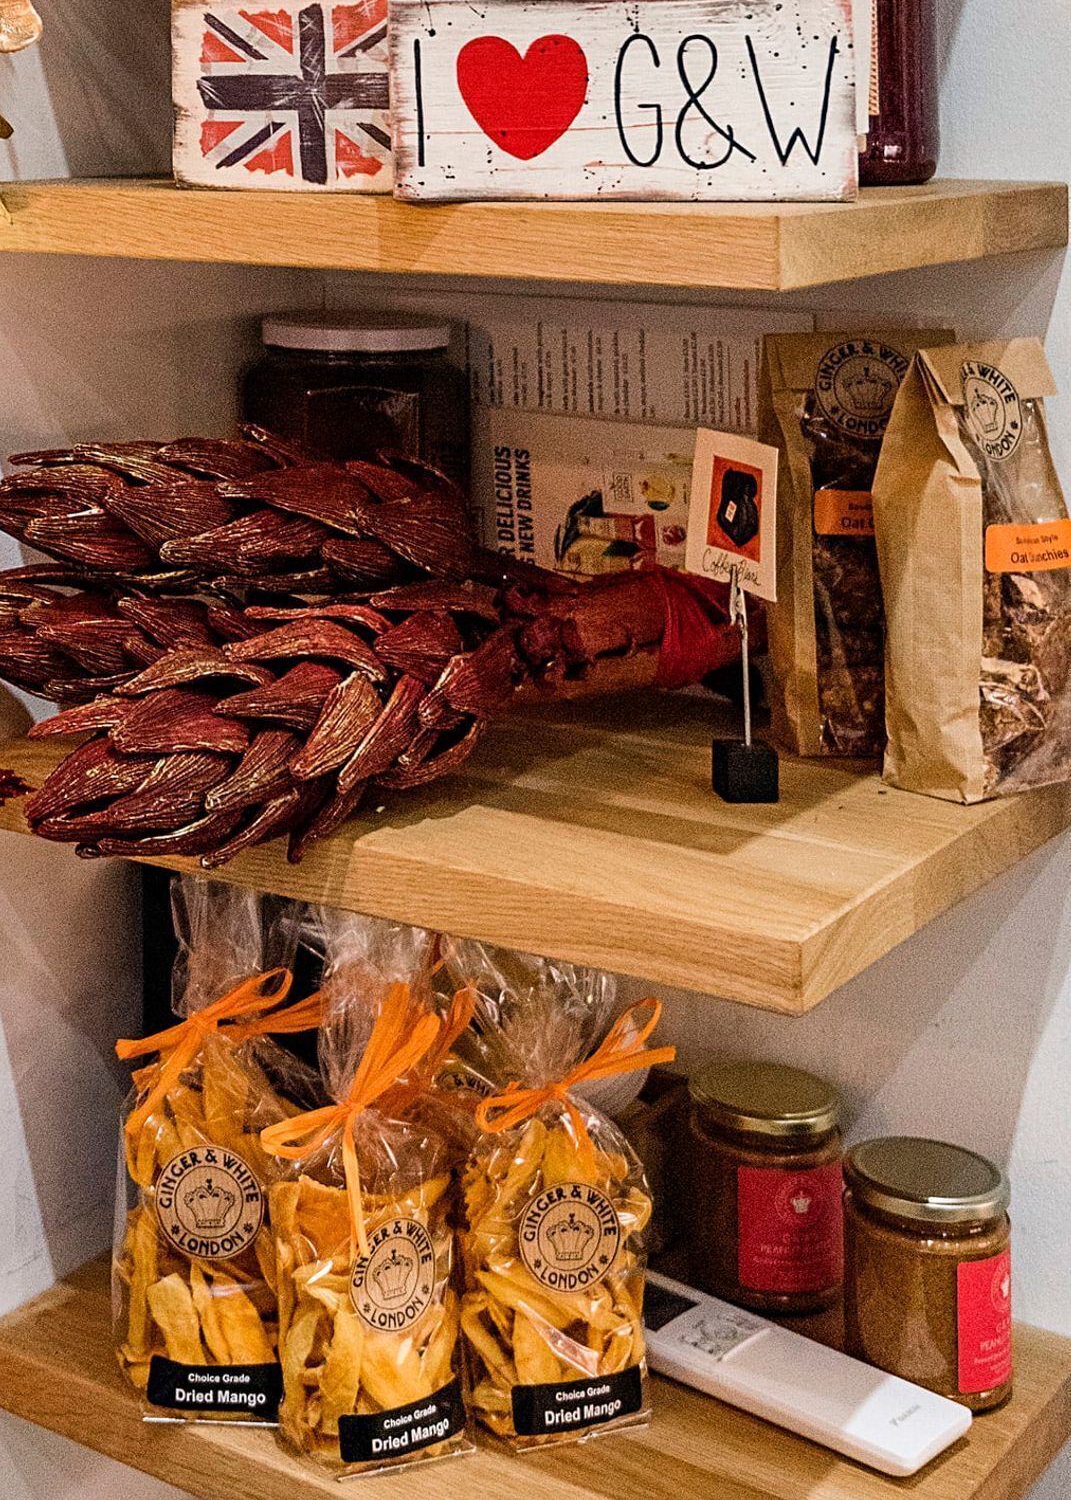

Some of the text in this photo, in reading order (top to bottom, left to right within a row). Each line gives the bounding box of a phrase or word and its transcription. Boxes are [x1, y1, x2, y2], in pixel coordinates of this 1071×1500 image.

[414, 38, 425, 167] I
[977, 364, 1016, 404] WHITE
[838, 412, 889, 435] LONDO
[494, 446, 515, 542] DELICIOUS
[514, 448, 533, 511] DRINKS
[516, 514, 535, 554] NEW
[1010, 550, 1029, 564] Oat
[159, 1148, 260, 1209] GINGER & WHITE
[523, 1184, 617, 1242] GINGER & WHITE
[178, 1231, 245, 1256] LONDON
[406, 1221, 432, 1265] WHITE
[540, 1263, 600, 1290] LONDON
[370, 1296, 425, 1329] LONDON
[188, 1372, 251, 1384] Choice Grade
[555, 1384, 611, 1402] Choice Grade
[175, 1387, 267, 1408] Dried Mango
[544, 1398, 622, 1427] Dried Mango
[383, 1404, 437, 1429] Choice Grade
[371, 1417, 450, 1453] Dried Mango
